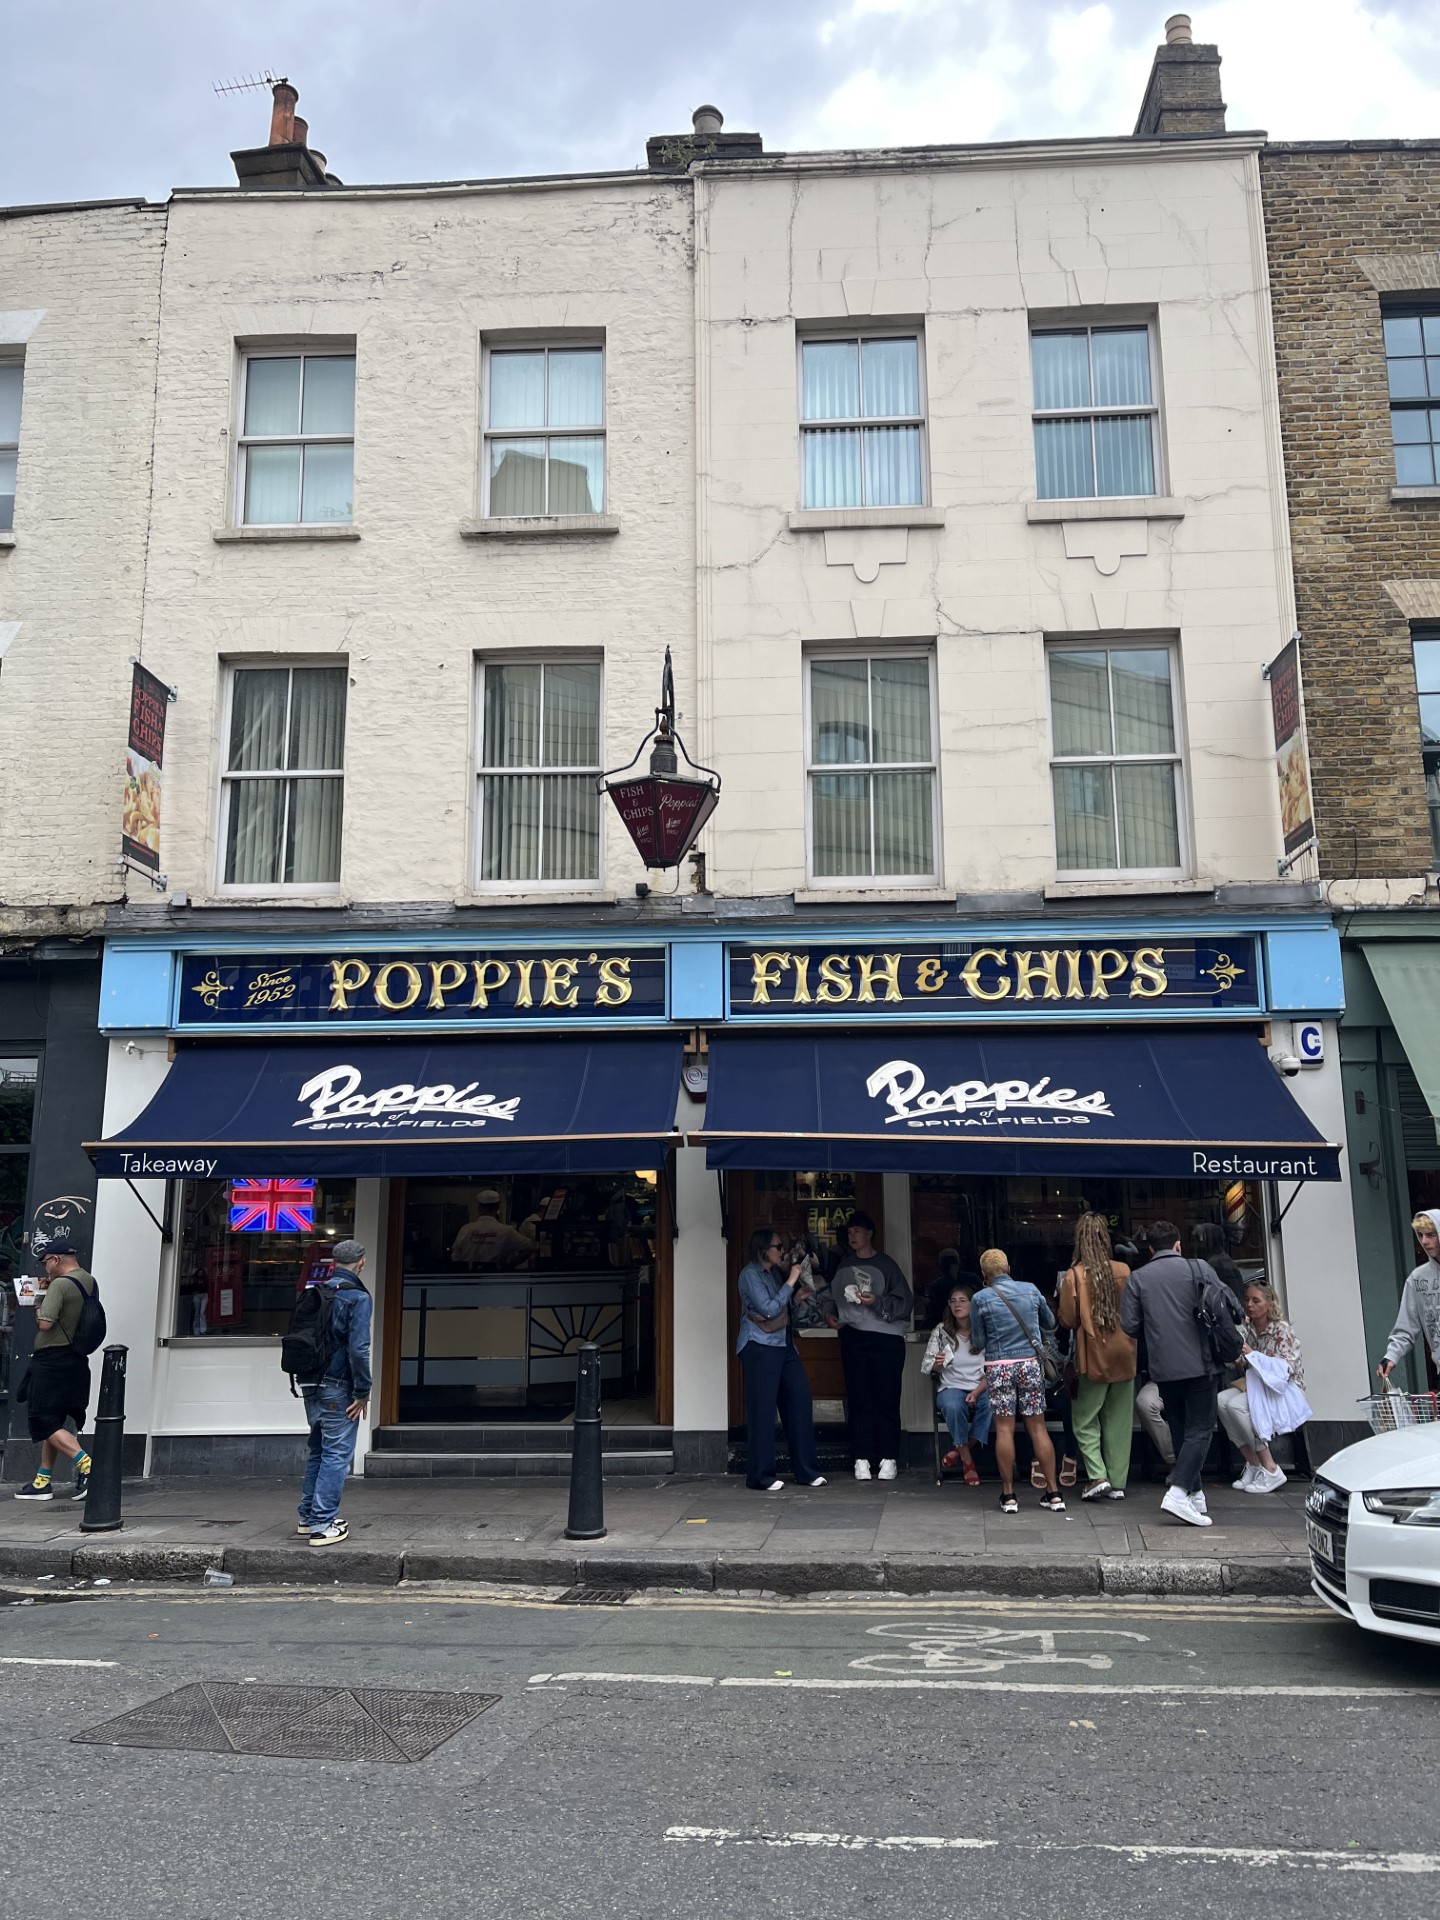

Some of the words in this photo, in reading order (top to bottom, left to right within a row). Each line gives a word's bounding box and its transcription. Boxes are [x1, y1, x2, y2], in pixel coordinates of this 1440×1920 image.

[133, 699, 158, 730] FISH
[132, 717, 162, 752] CHIPS
[620, 785, 645, 799] FISH
[632, 798, 639, 807] &
[623, 806, 655, 820] CHIPS
[248, 967, 293, 992] Since
[328, 953, 634, 1012] POPPIE'S
[750, 951, 904, 1005] FISH
[915, 958, 949, 993] &
[959, 947, 1168, 1001] CHIPS
[243, 984, 295, 1008] 1952
[1301, 1026, 1321, 1057] C
[296, 1064, 521, 1118] Poppies
[866, 1060, 1112, 1117] Poppies
[308, 1119, 486, 1130] SPITALFIELDS
[387, 1111, 407, 1121] of
[906, 1115, 1091, 1128] SPITALFIELDS
[980, 1108, 996, 1118] of
[119, 1152, 218, 1178] Takeaway
[1193, 1151, 1318, 1175] Restaurant
